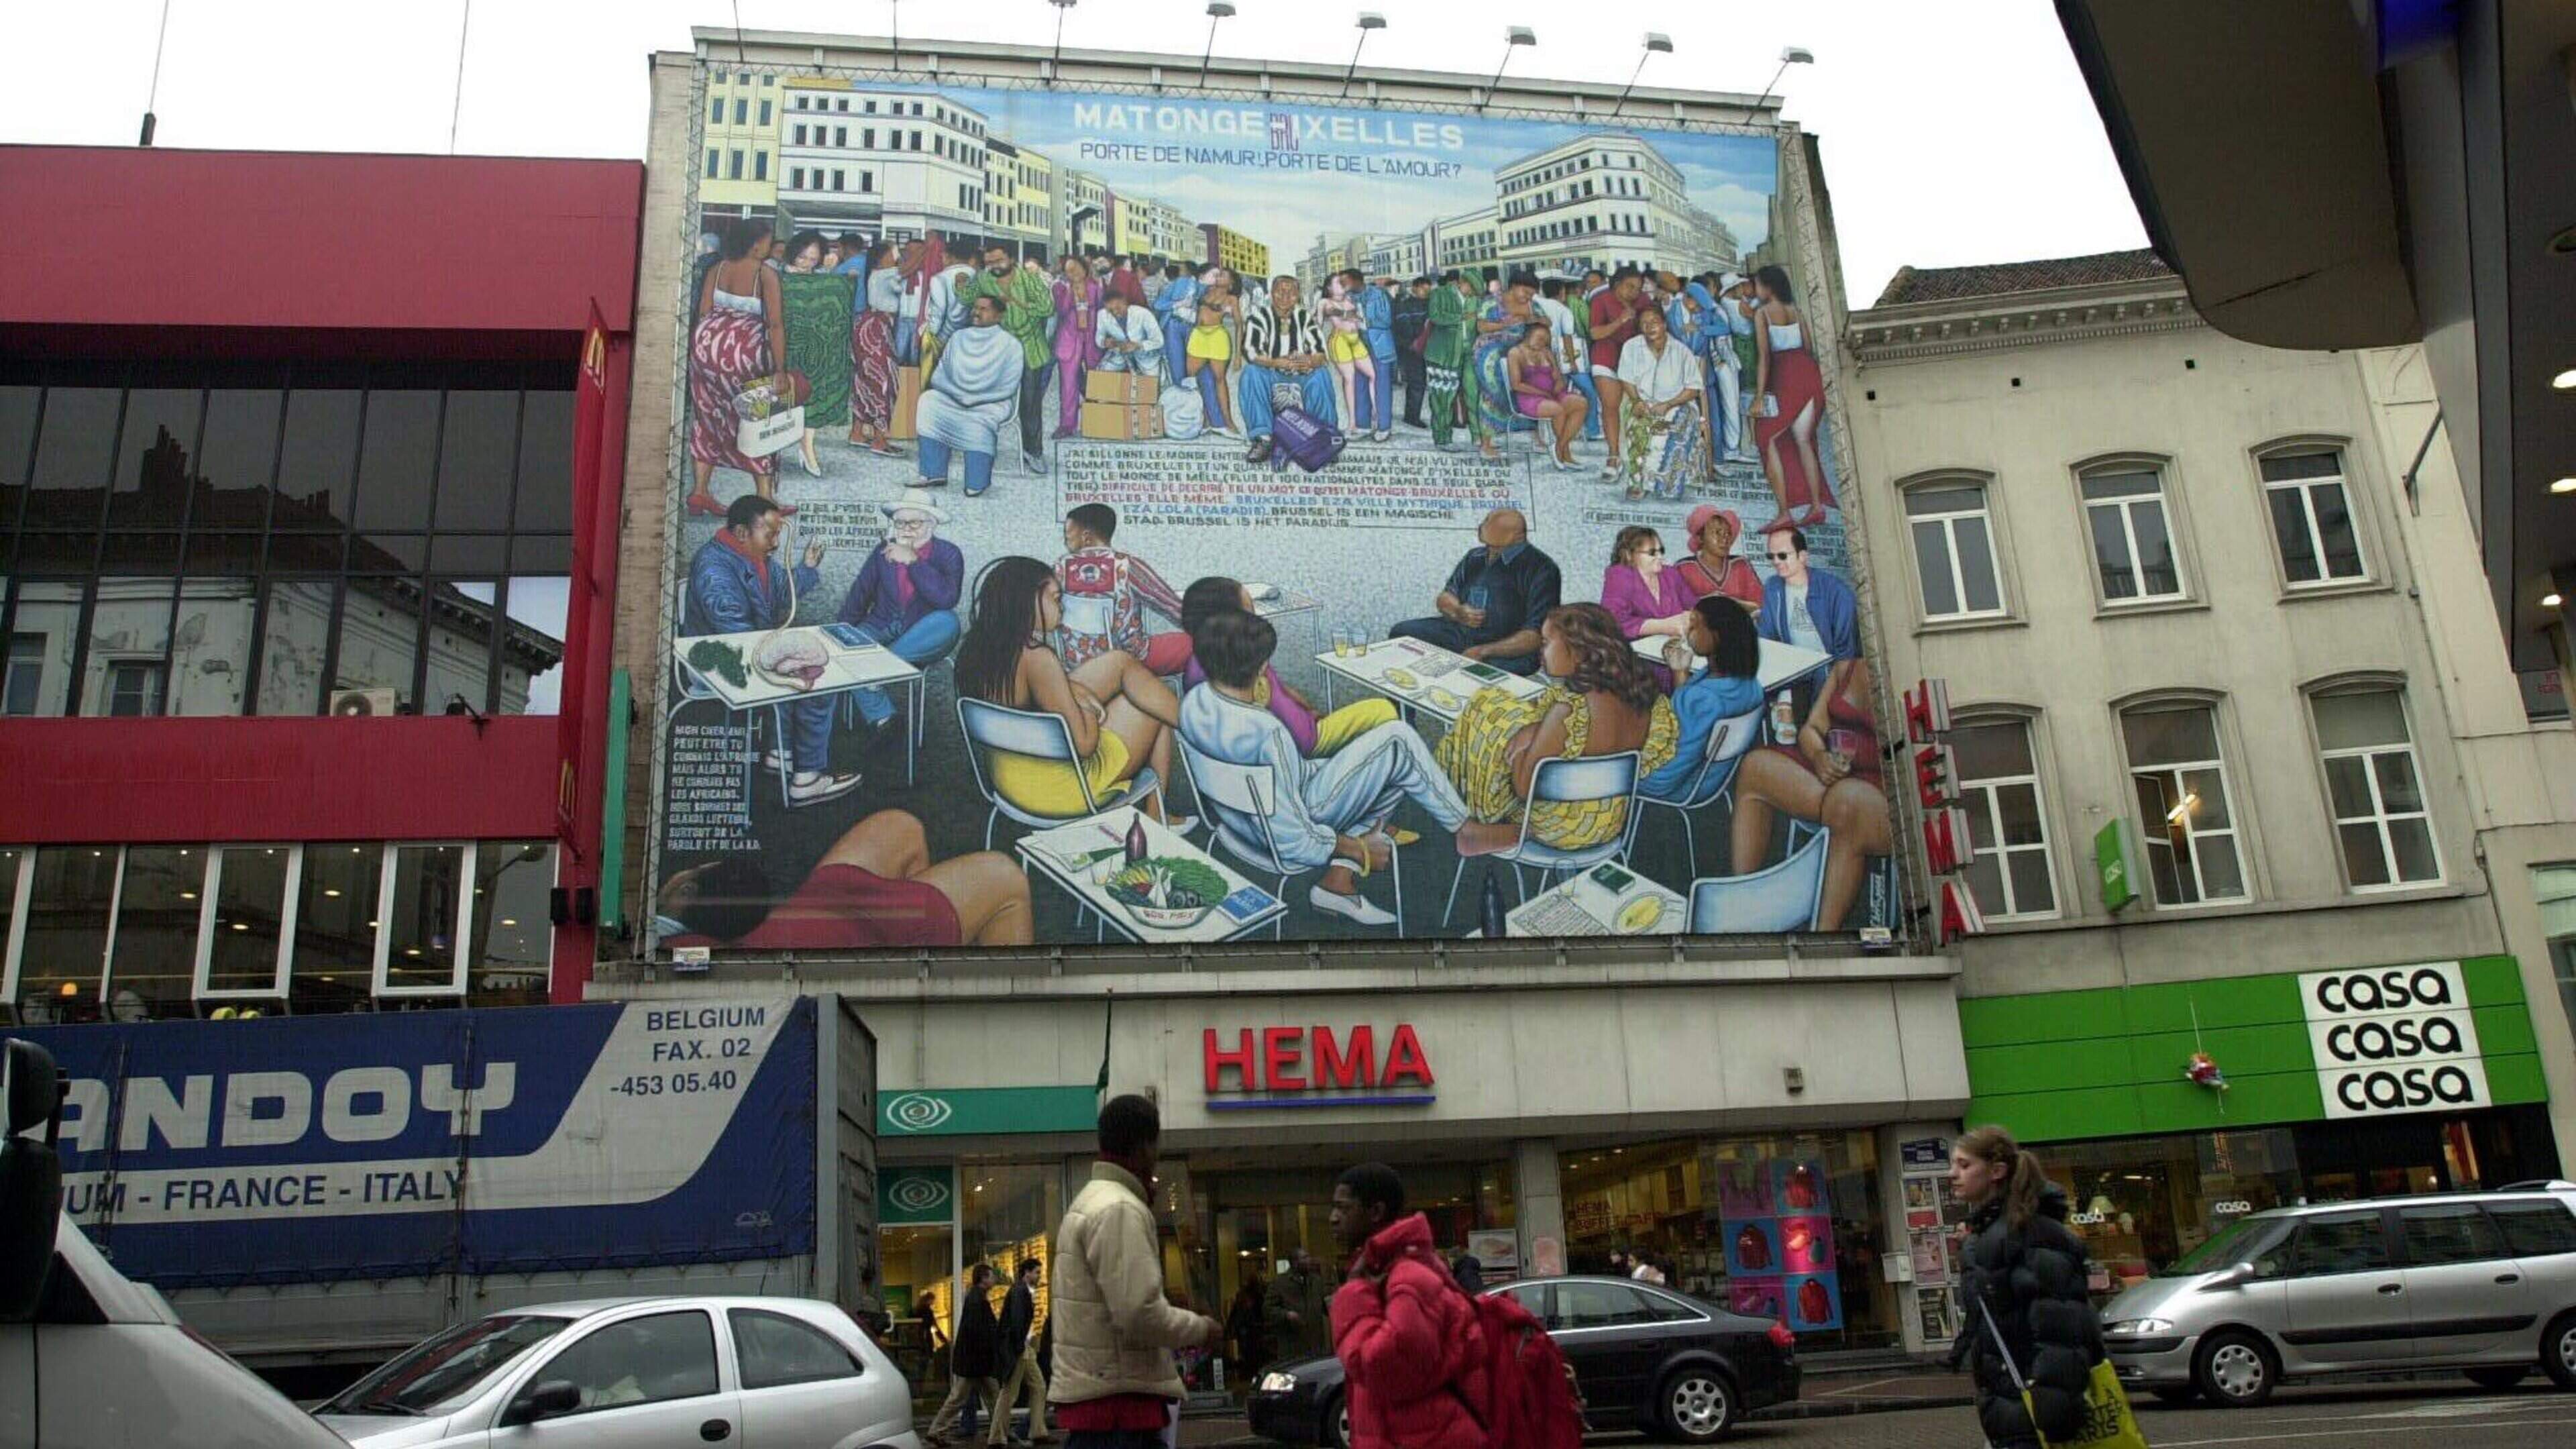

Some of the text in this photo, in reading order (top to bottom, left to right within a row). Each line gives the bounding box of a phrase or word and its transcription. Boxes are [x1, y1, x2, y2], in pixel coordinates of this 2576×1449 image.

[1080, 142, 1147, 162] PORTE
[1154, 146, 1179, 163] DE
[1265, 151, 1330, 171] PORTE
[1336, 155, 1360, 173] DE
[1149, 451, 1163, 460] LE
[1167, 451, 1208, 461] MONDE
[1433, 457, 1448, 466] VU
[1452, 458, 1474, 467] UNE
[1065, 460, 1112, 470] COMME
[1118, 461, 1192, 471] BRUXELLES
[1197, 462, 1210, 472] ET
[1213, 463, 1229, 472] UN
[1495, 468, 1511, 477] OU
[1067, 472, 1095, 480] TOUT
[1102, 472, 1117, 481] LE
[1120, 472, 1162, 481] MONDE
[1168, 472, 1181, 481] SE
[1262, 474, 1274, 483] DE
[1281, 474, 1300, 484] 100
[1389, 476, 1419, 486] DANS
[1424, 477, 1437, 486] CE
[1443, 478, 1472, 488] SEUL
[1102, 482, 1157, 492] DIFFICILE
[1162, 483, 1175, 492] DE
[1248, 484, 1265, 494] UN
[1269, 484, 1295, 494] MOT
[1492, 490, 1509, 498] OU
[1066, 493, 1142, 502] BRUXELLES
[1148, 494, 1179, 503] ELLE
[1236, 495, 1317, 506] BRUXELLES
[1322, 496, 1352, 506] EZA
[1356, 498, 1393, 508] VILLE
[1123, 504, 1152, 513] EZA
[1158, 504, 1193, 514] LOLA
[1272, 506, 1334, 517] BRUSSEL
[1337, 508, 1350, 517] IS
[1355, 508, 1380, 518] EEN
[1384, 509, 1455, 519] MAGISCHE
[1167, 515, 1232, 526] BRUSSEL
[1237, 516, 1250, 526] IS
[1256, 517, 1280, 527] HET
[674, 738, 699, 749] PEUT
[731, 739, 743, 749] TU
[673, 763, 695, 774] MAIS
[697, 764, 727, 775] ALORS
[725, 777, 741, 788] PAS
[672, 789, 687, 800] LES
[1904, 678, 1971, 947] HEMA
[714, 827, 727, 838] DE
[729, 827, 743, 837] LA
[704, 839, 718, 850] ET
[732, 839, 745, 850] LA
[2316, 968, 2452, 1014] casa
[647, 1006, 765, 1032] BELGIUM
[2326, 1016, 2463, 1062] casa
[653, 1037, 751, 1063] FAX. 02
[1203, 1024, 1435, 1093] HEMA
[610, 1069, 737, 1098] -453 05.40
[2337, 1065, 2475, 1112] casa
[164, 1175, 327, 1211] FRANCE
[363, 1168, 465, 1204] ITALY
[2215, 1201, 2251, 1214] casa
[2070, 1212, 2105, 1224] casa
